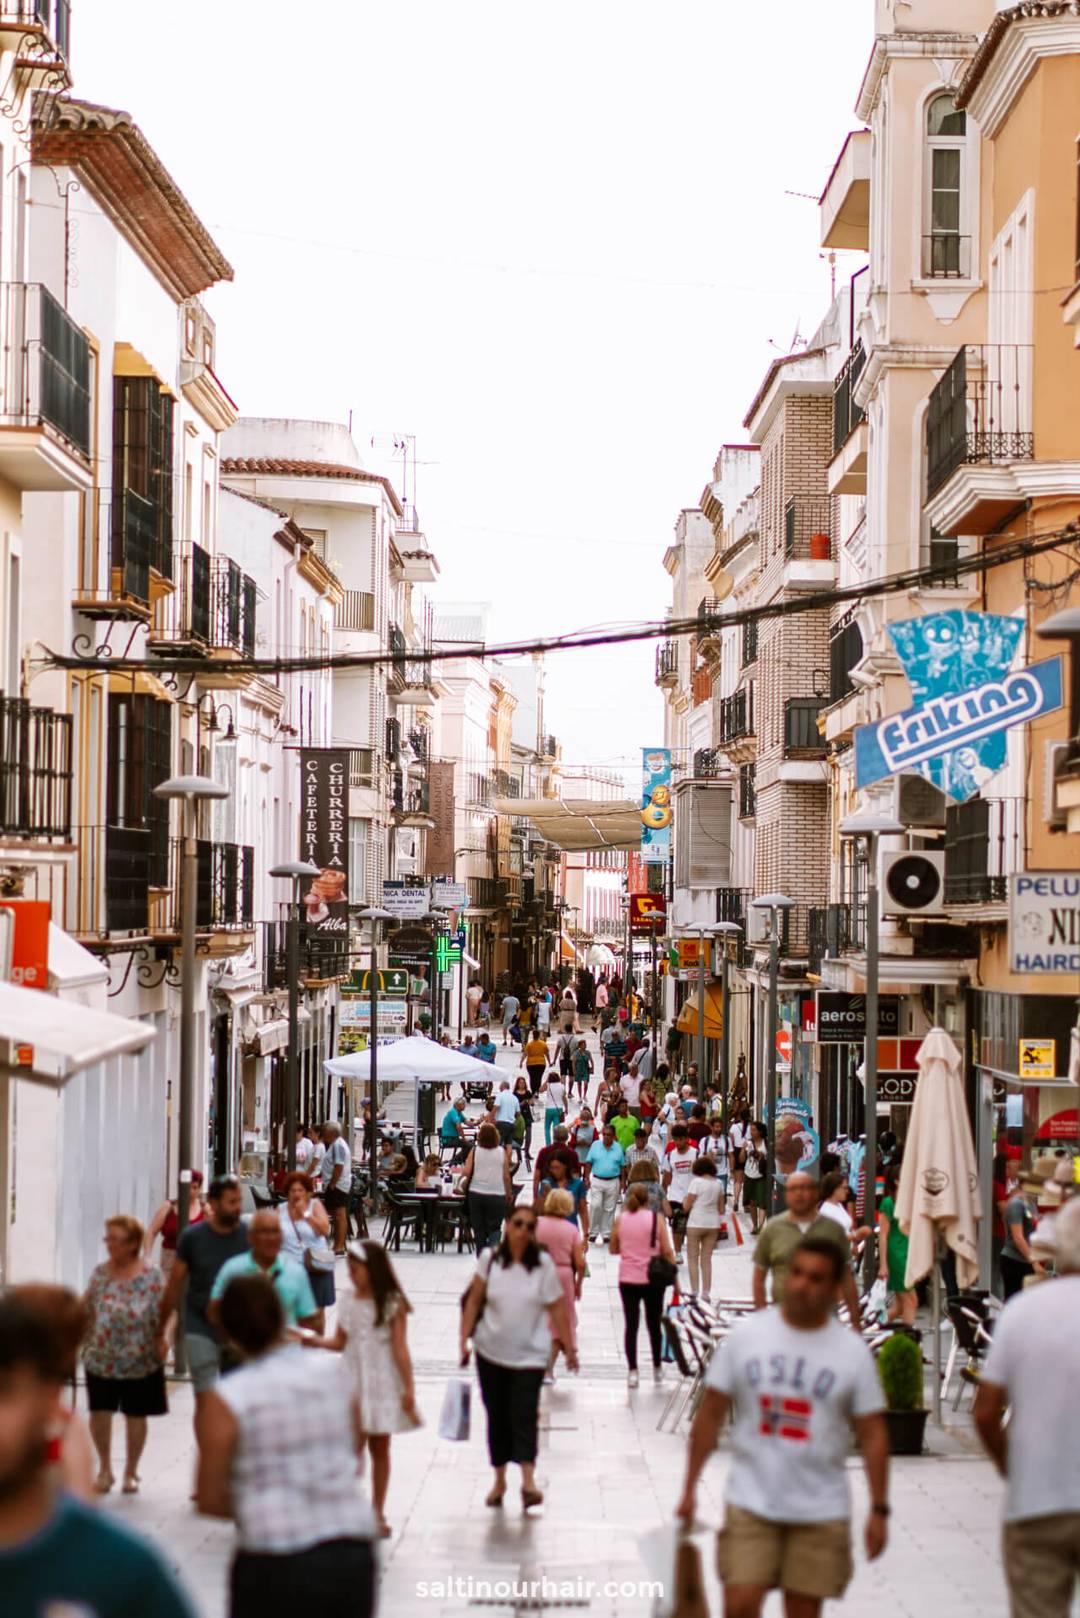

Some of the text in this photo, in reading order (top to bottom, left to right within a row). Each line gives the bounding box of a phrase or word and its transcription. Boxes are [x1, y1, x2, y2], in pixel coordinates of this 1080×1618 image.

[317, 917, 347, 931] Alba
[1048, 907, 1080, 946] NI
[821, 1010, 896, 1022] aerosto
